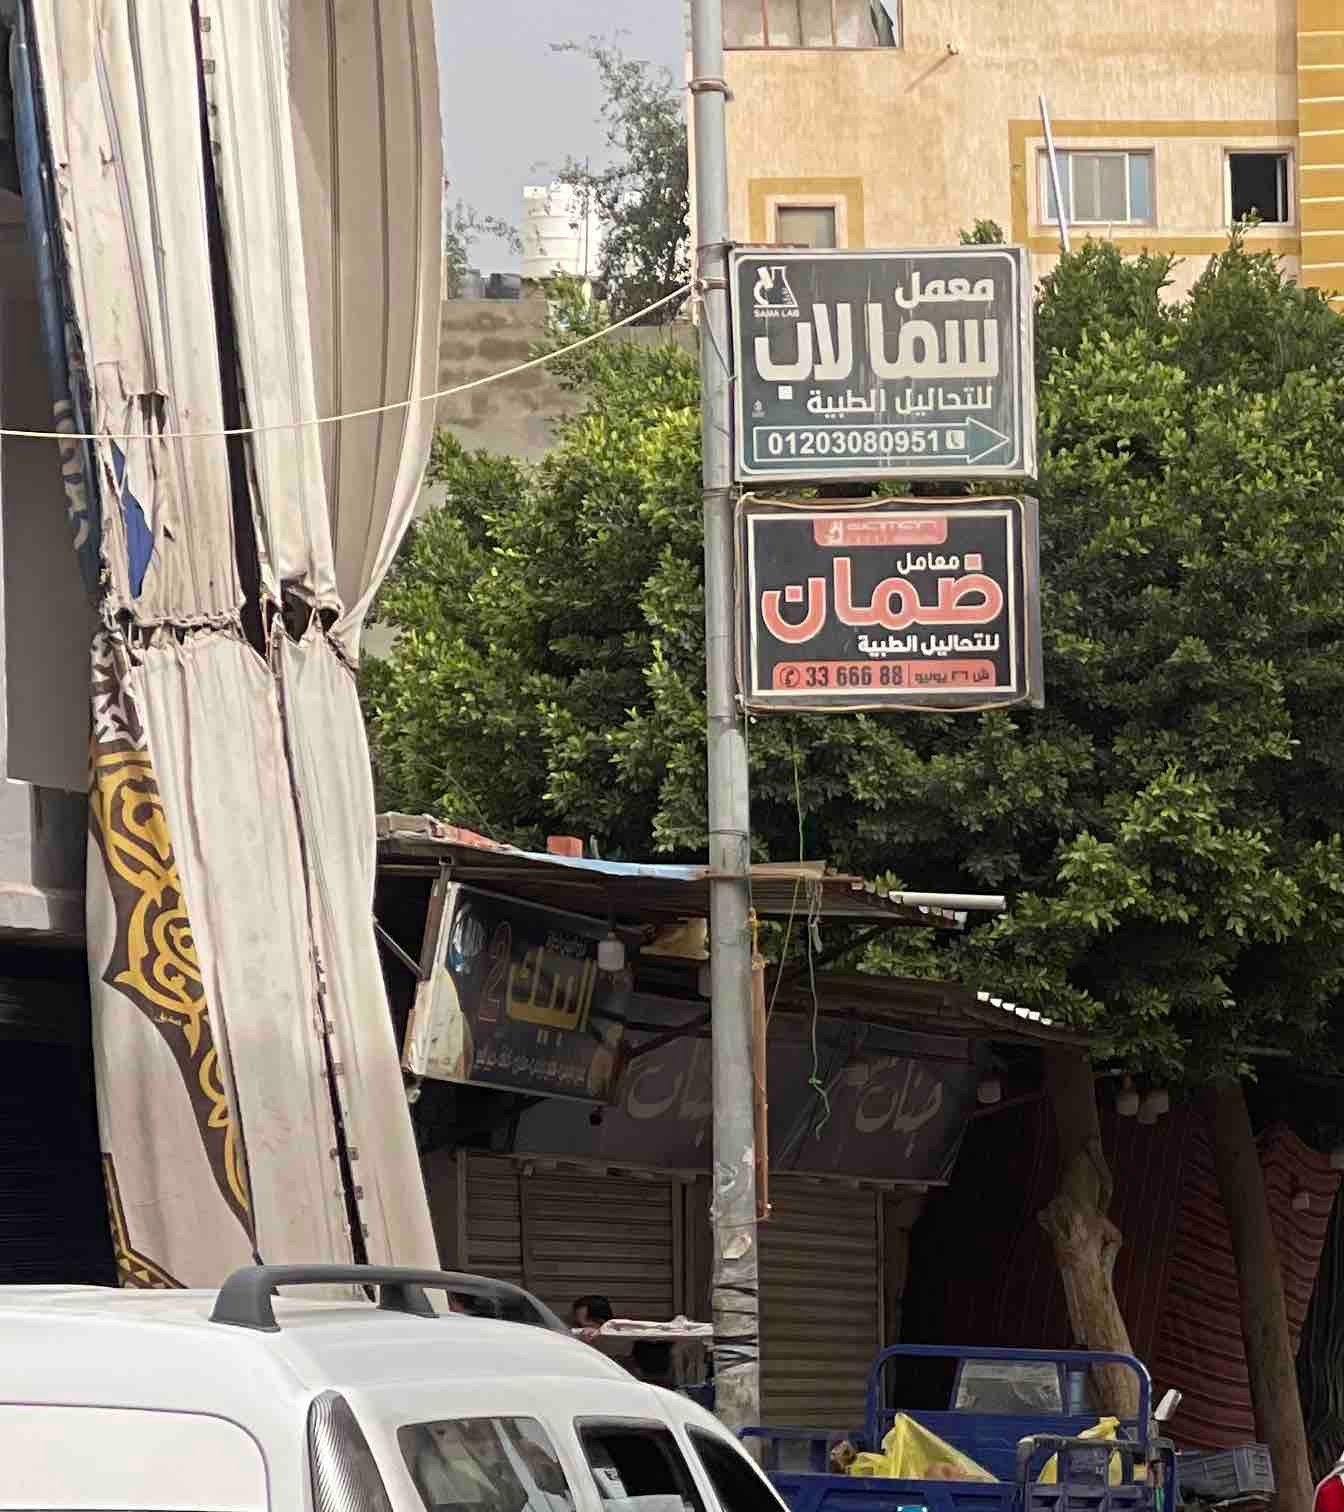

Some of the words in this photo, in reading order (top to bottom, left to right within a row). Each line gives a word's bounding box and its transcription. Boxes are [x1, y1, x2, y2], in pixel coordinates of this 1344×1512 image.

[895, 271, 995, 310] معمل
[753, 309, 780, 318] SAMA
[782, 308, 800, 318] LAB
[754, 302, 853, 400] لاب
[864, 302, 1000, 379] سما
[806, 388, 886, 419] الطبية
[896, 385, 993, 417] للتحاليل
[767, 430, 940, 455] 01203080951
[896, 552, 960, 575] معامل
[761, 553, 1004, 645] ضمان
[857, 634, 918, 658] الطبية
[920, 632, 1001, 657] للتحاليل
